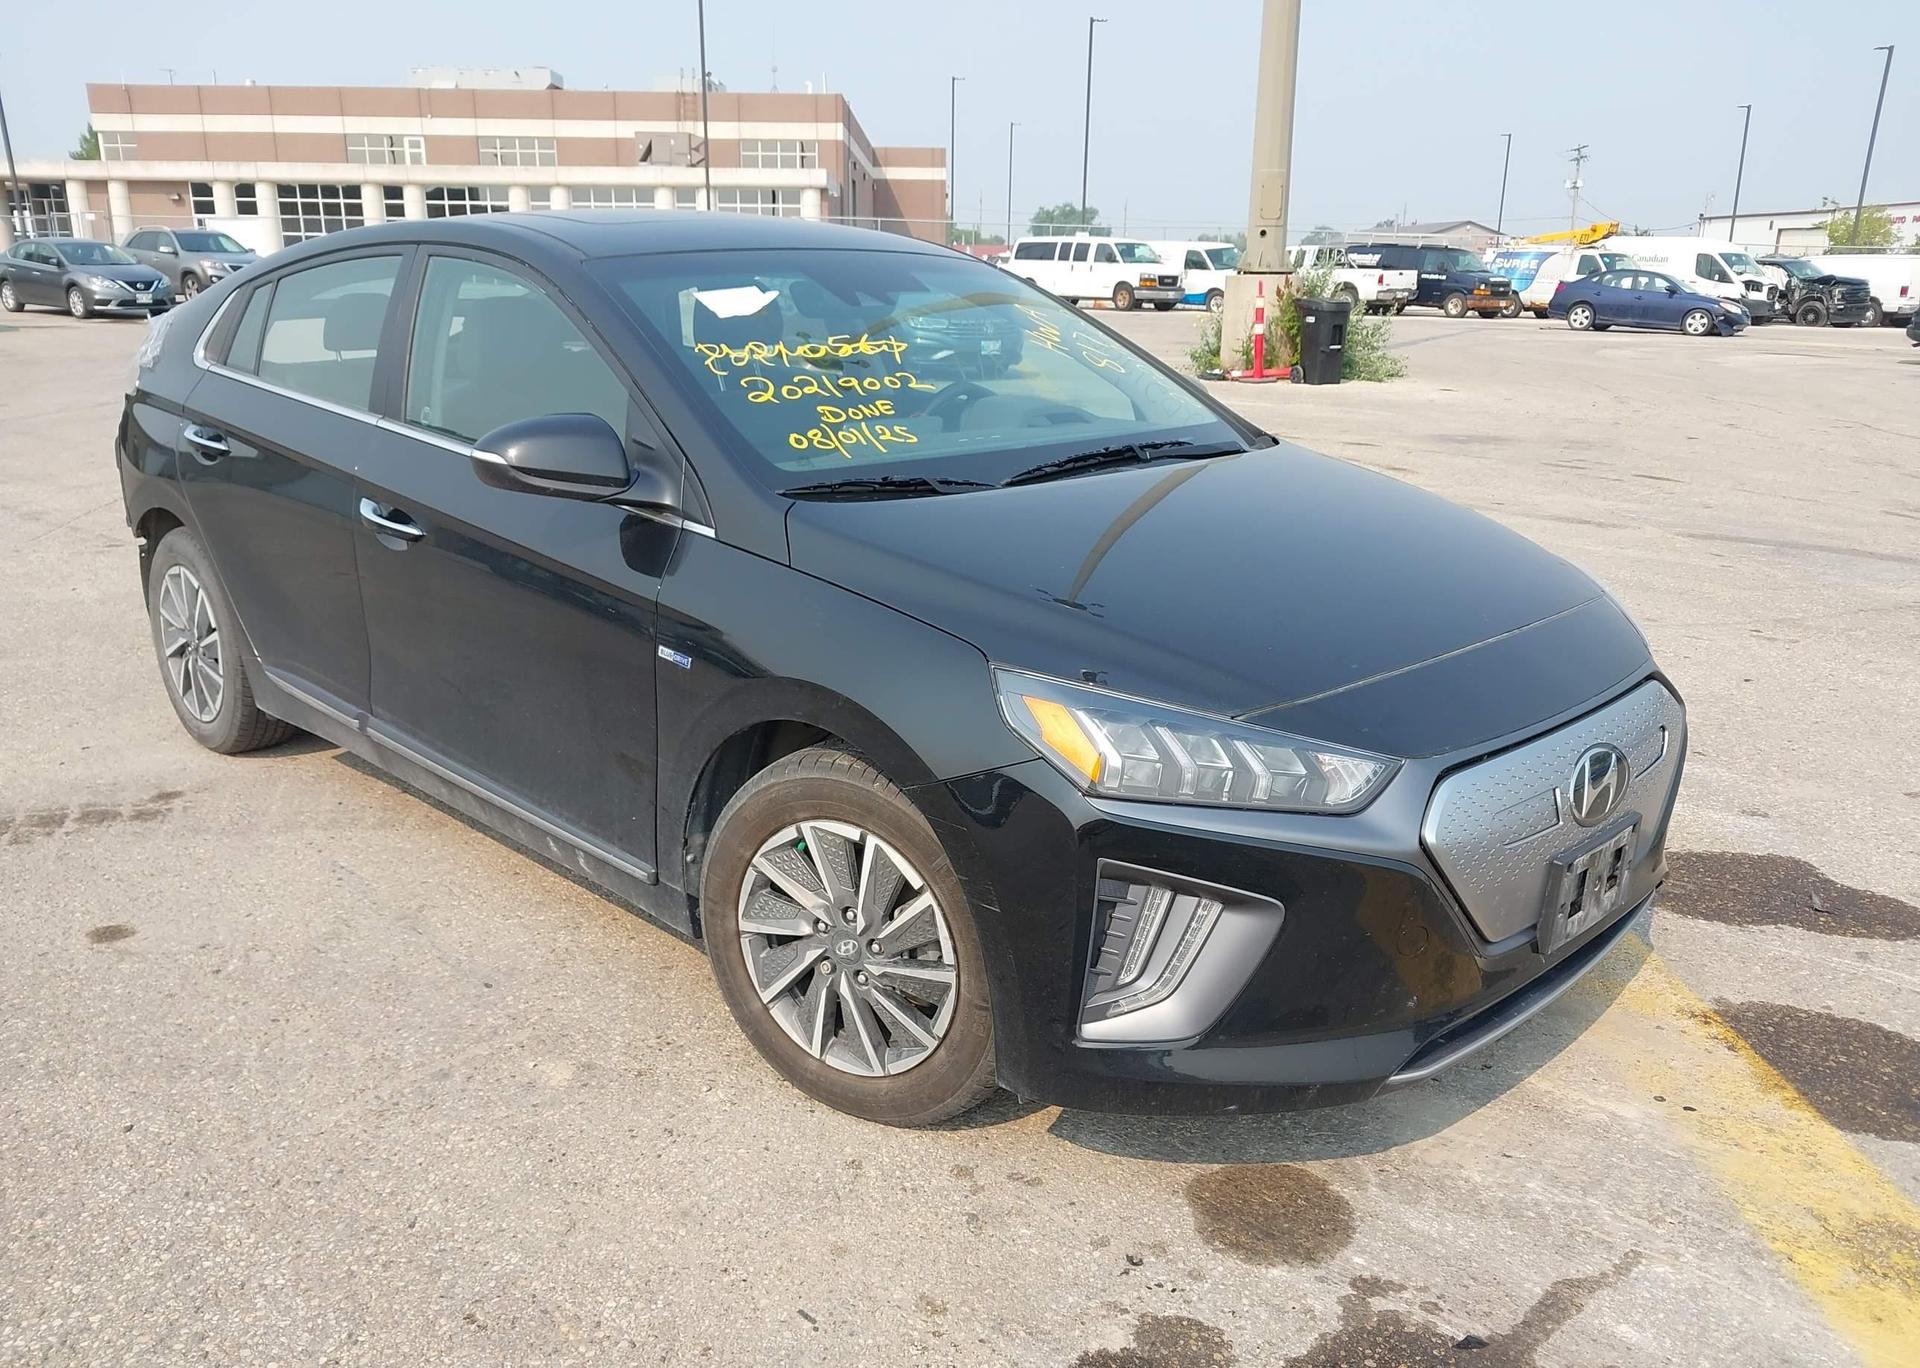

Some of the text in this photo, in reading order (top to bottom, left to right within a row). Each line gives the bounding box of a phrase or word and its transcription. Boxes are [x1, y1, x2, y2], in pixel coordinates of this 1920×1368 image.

[1495, 258, 1539, 269] SURGE
[1632, 253, 1669, 264] Canadian
[816, 399, 896, 423] DONE
[788, 421, 919, 459] 08/01/25
